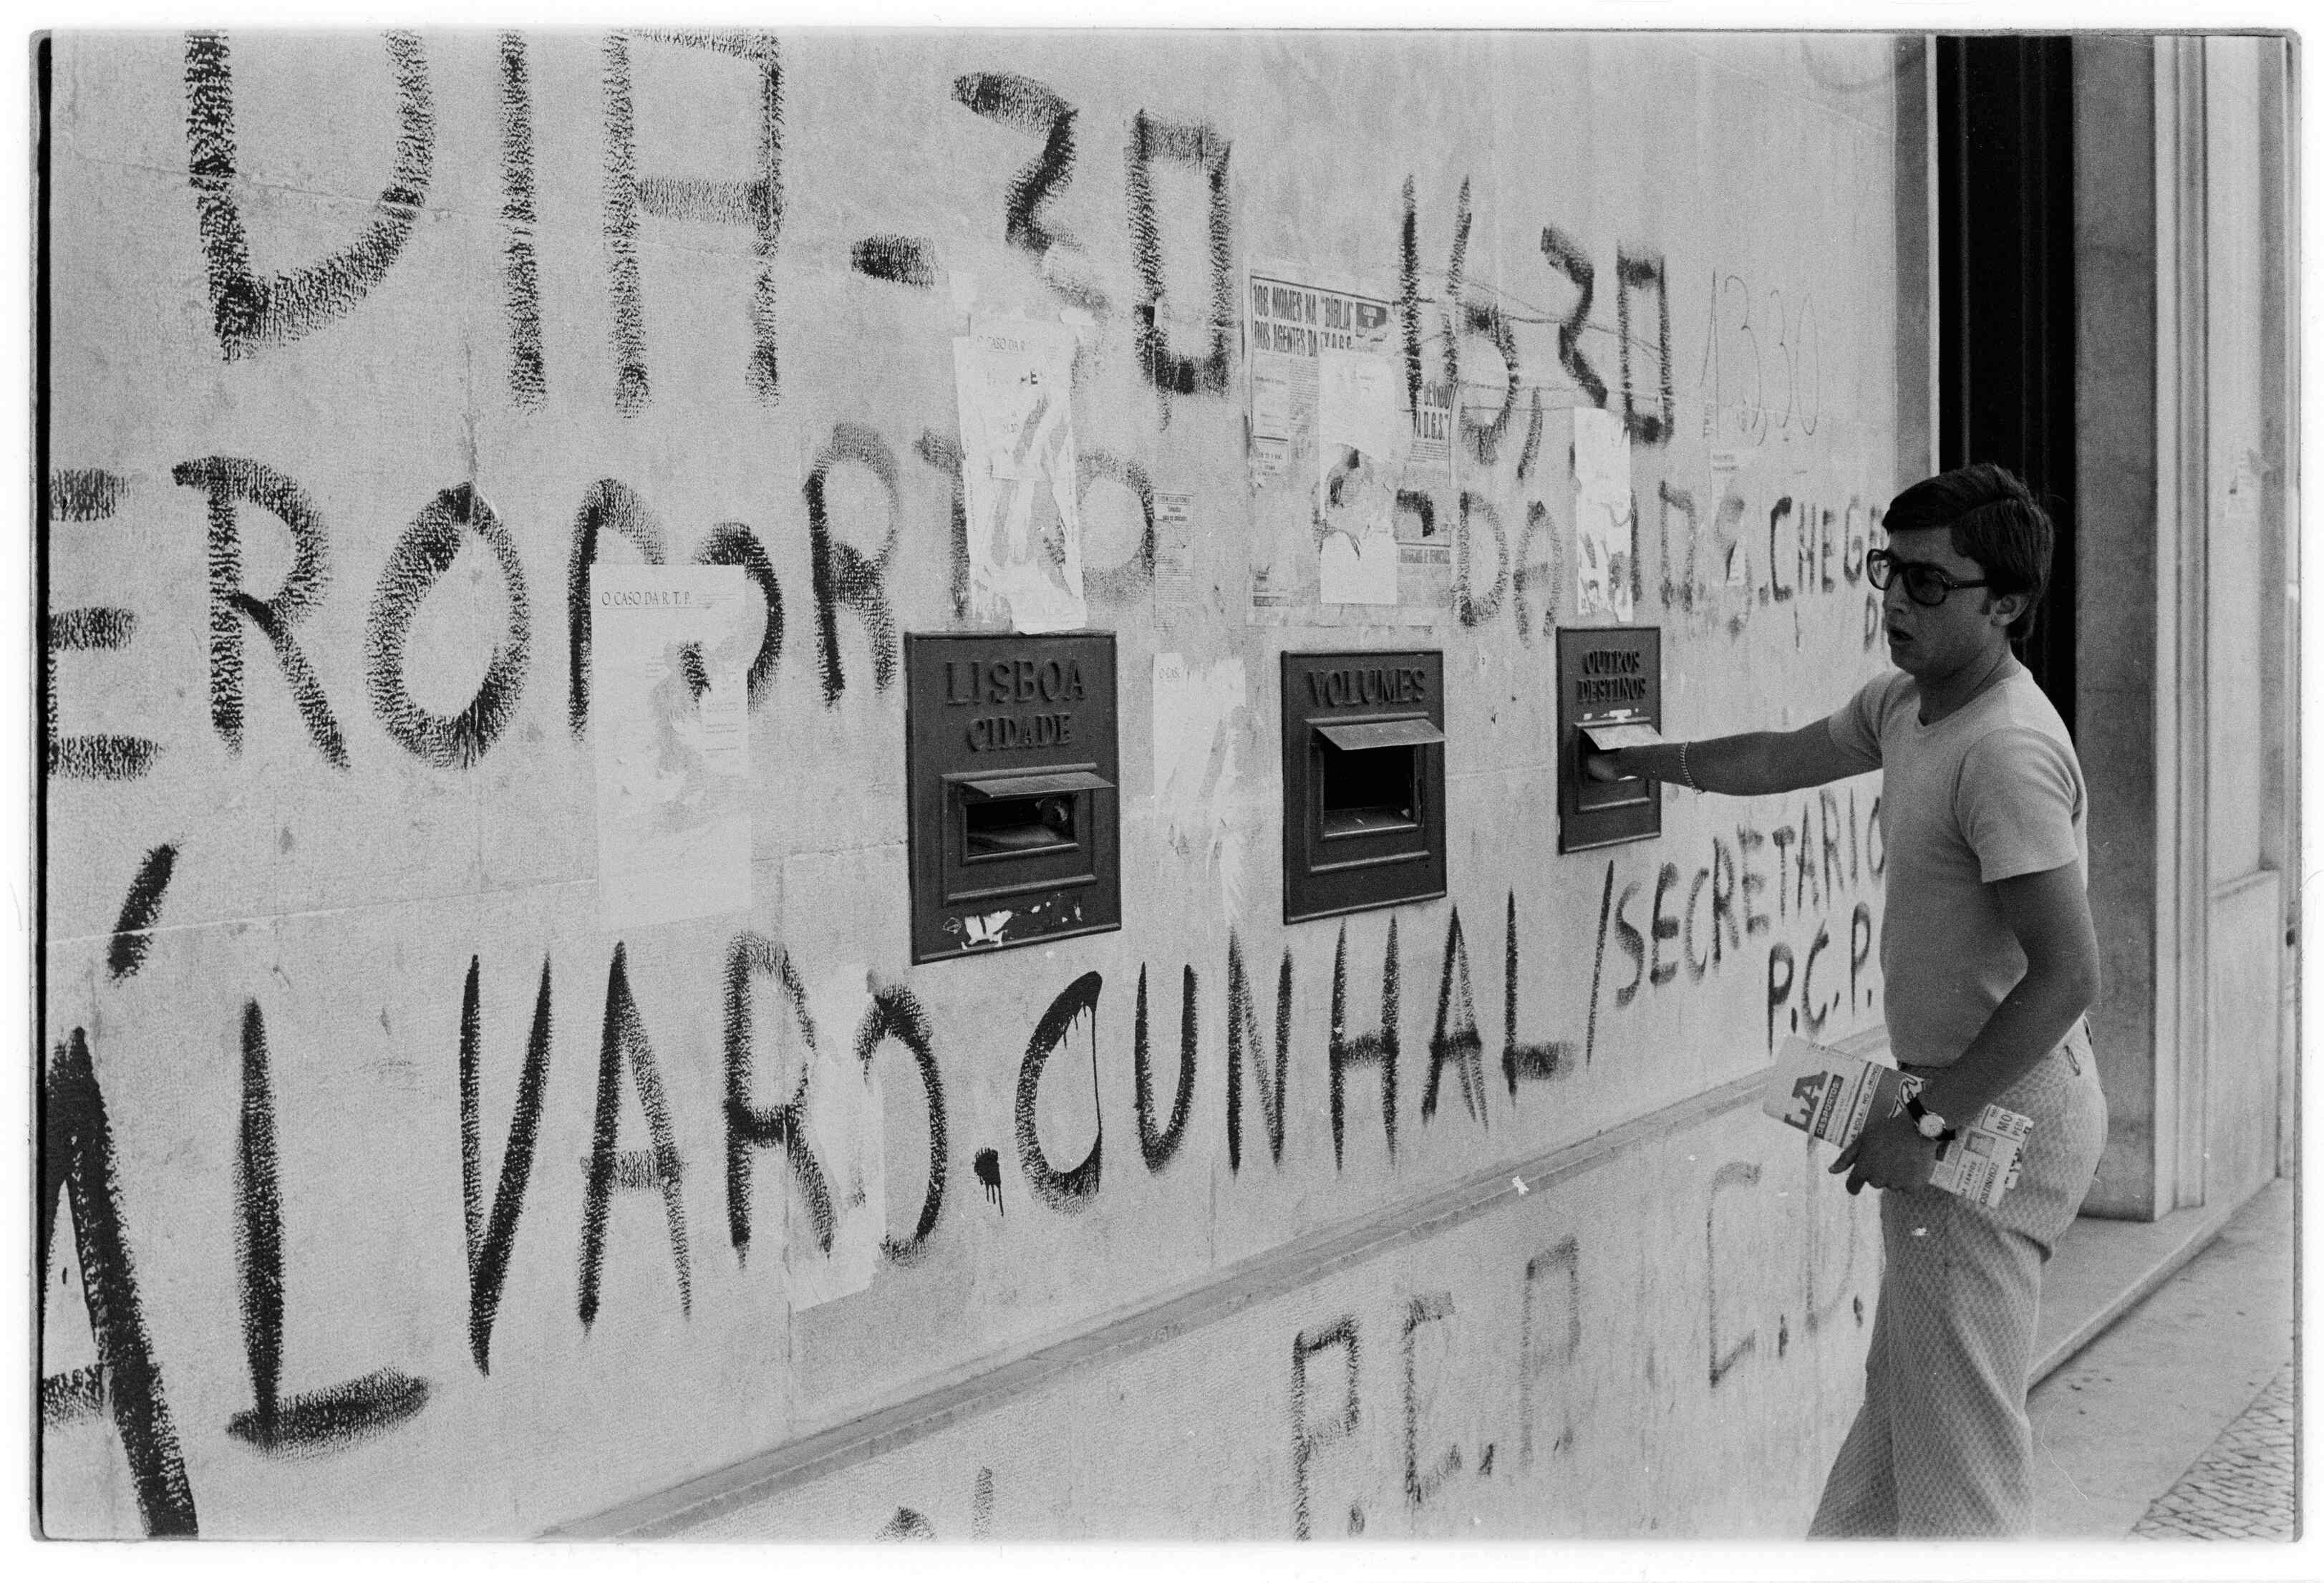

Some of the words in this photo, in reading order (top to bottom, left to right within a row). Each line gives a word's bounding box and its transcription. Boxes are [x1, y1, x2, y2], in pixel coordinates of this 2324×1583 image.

[1272, 287, 1302, 323] NOMES
[1254, 320, 1270, 351] DOS
[1274, 324, 1305, 357] AGENTES
[602, 591, 611, 606] O
[614, 591, 641, 606] CASO
[644, 591, 659, 606] DA
[1582, 648, 1640, 674] OUTROS
[944, 657, 1086, 707] LISBOA
[1304, 668, 1427, 708] VOLUMES
[1575, 676, 1646, 702] DESTINOS
[965, 713, 1073, 752] CIDADE
[1766, 901, 1873, 1057] P.C.P.
